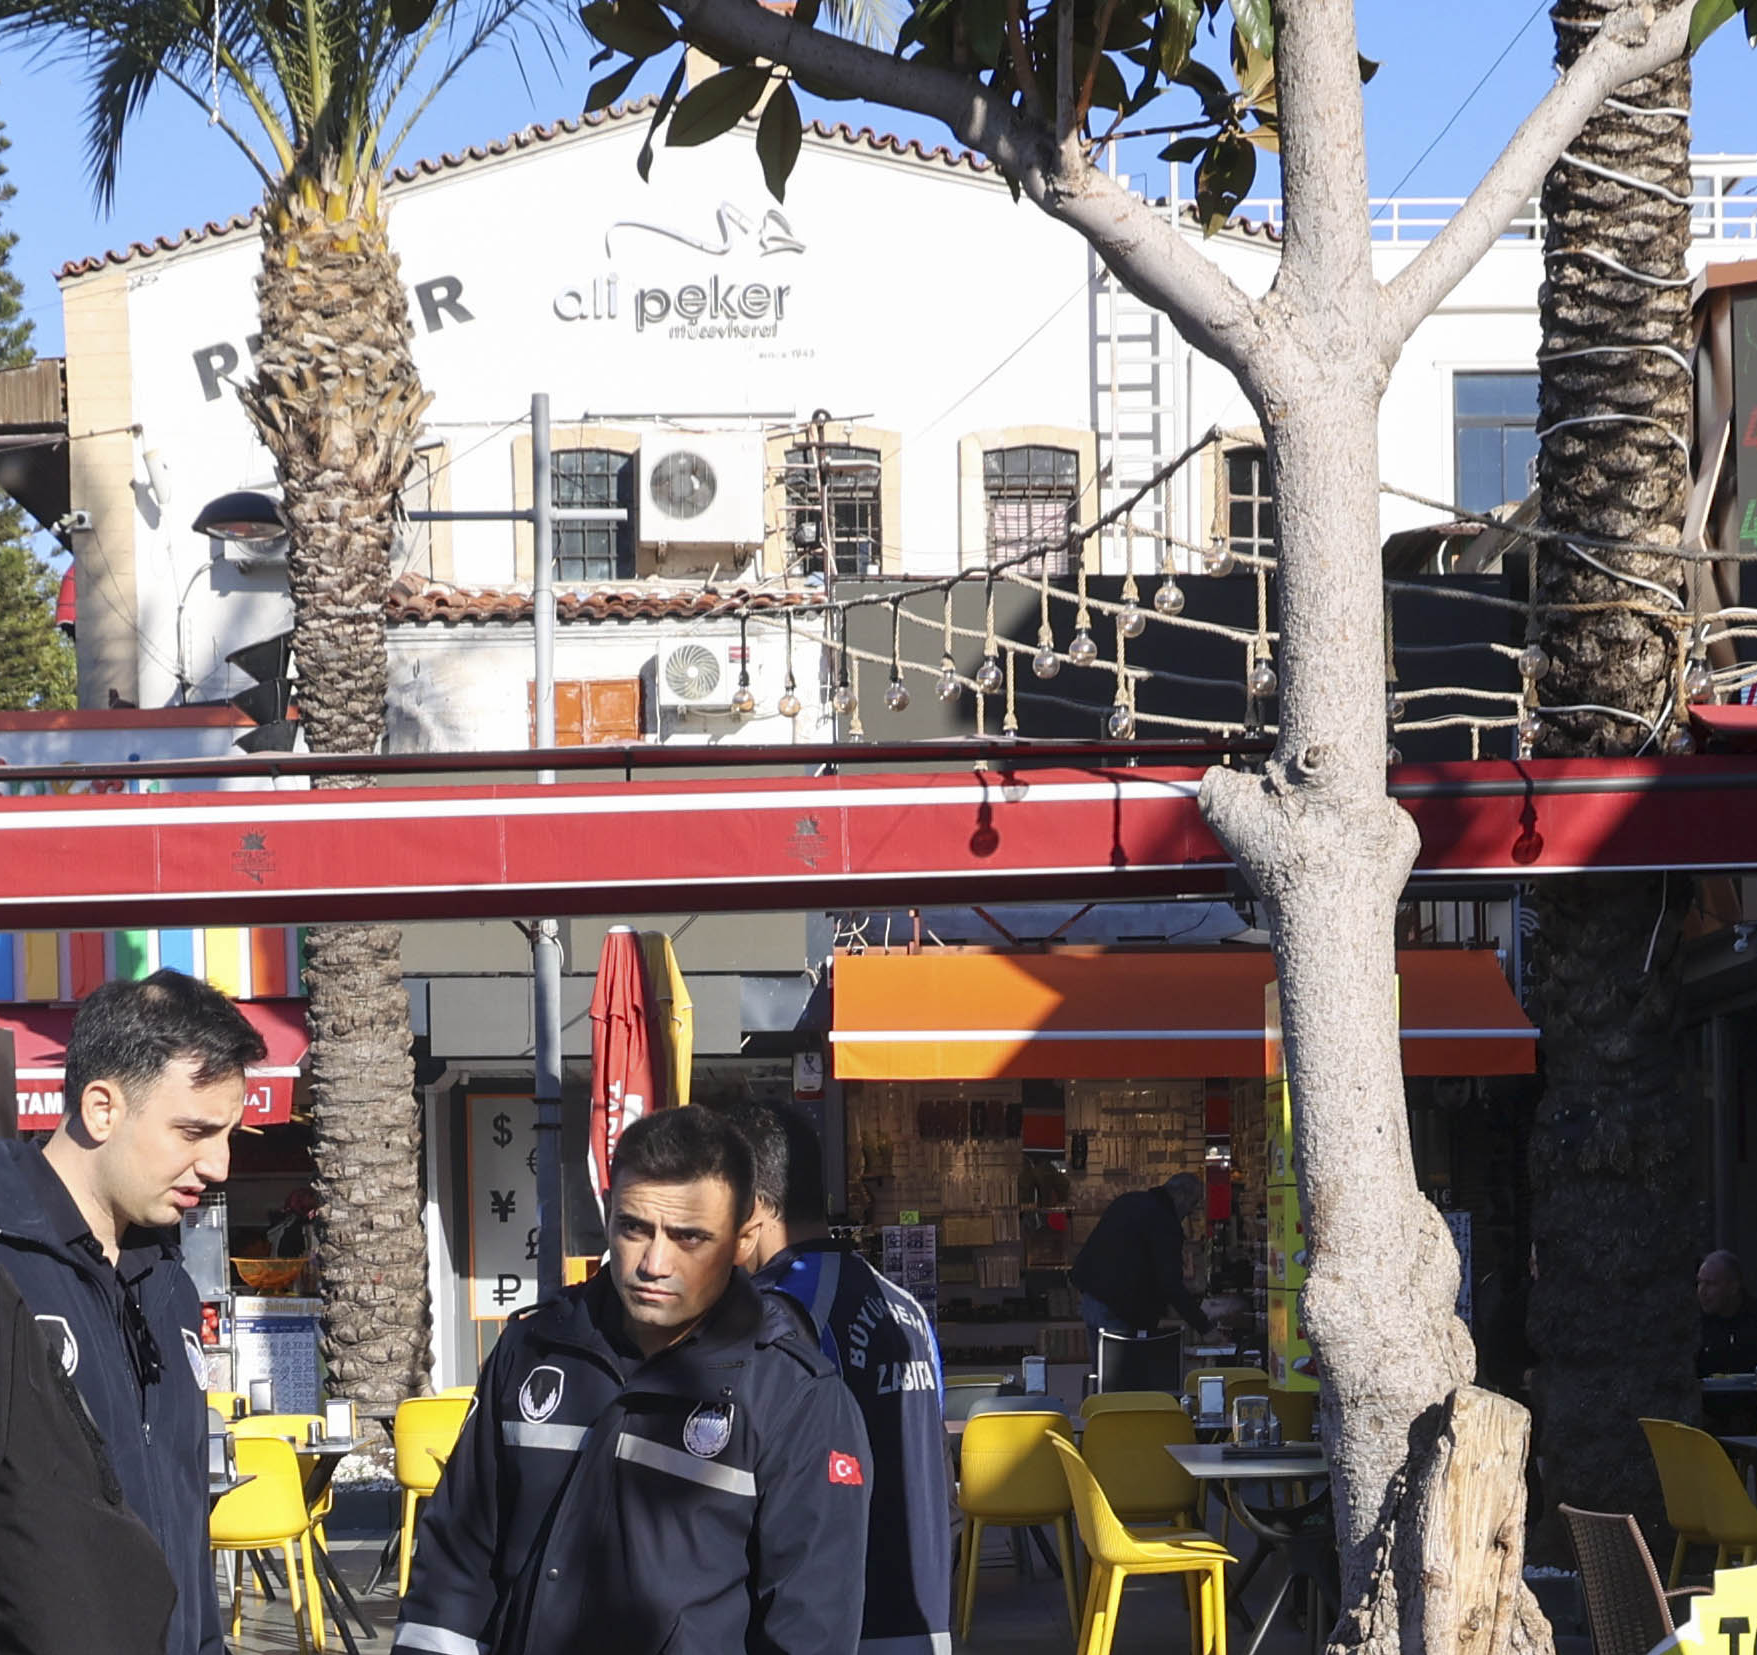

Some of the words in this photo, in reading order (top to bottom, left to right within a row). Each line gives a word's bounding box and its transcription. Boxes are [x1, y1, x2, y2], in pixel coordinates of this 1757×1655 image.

[553, 272, 618, 322] ali
[635, 273, 791, 332] peker
[877, 1360, 936, 1395] ZABITA
